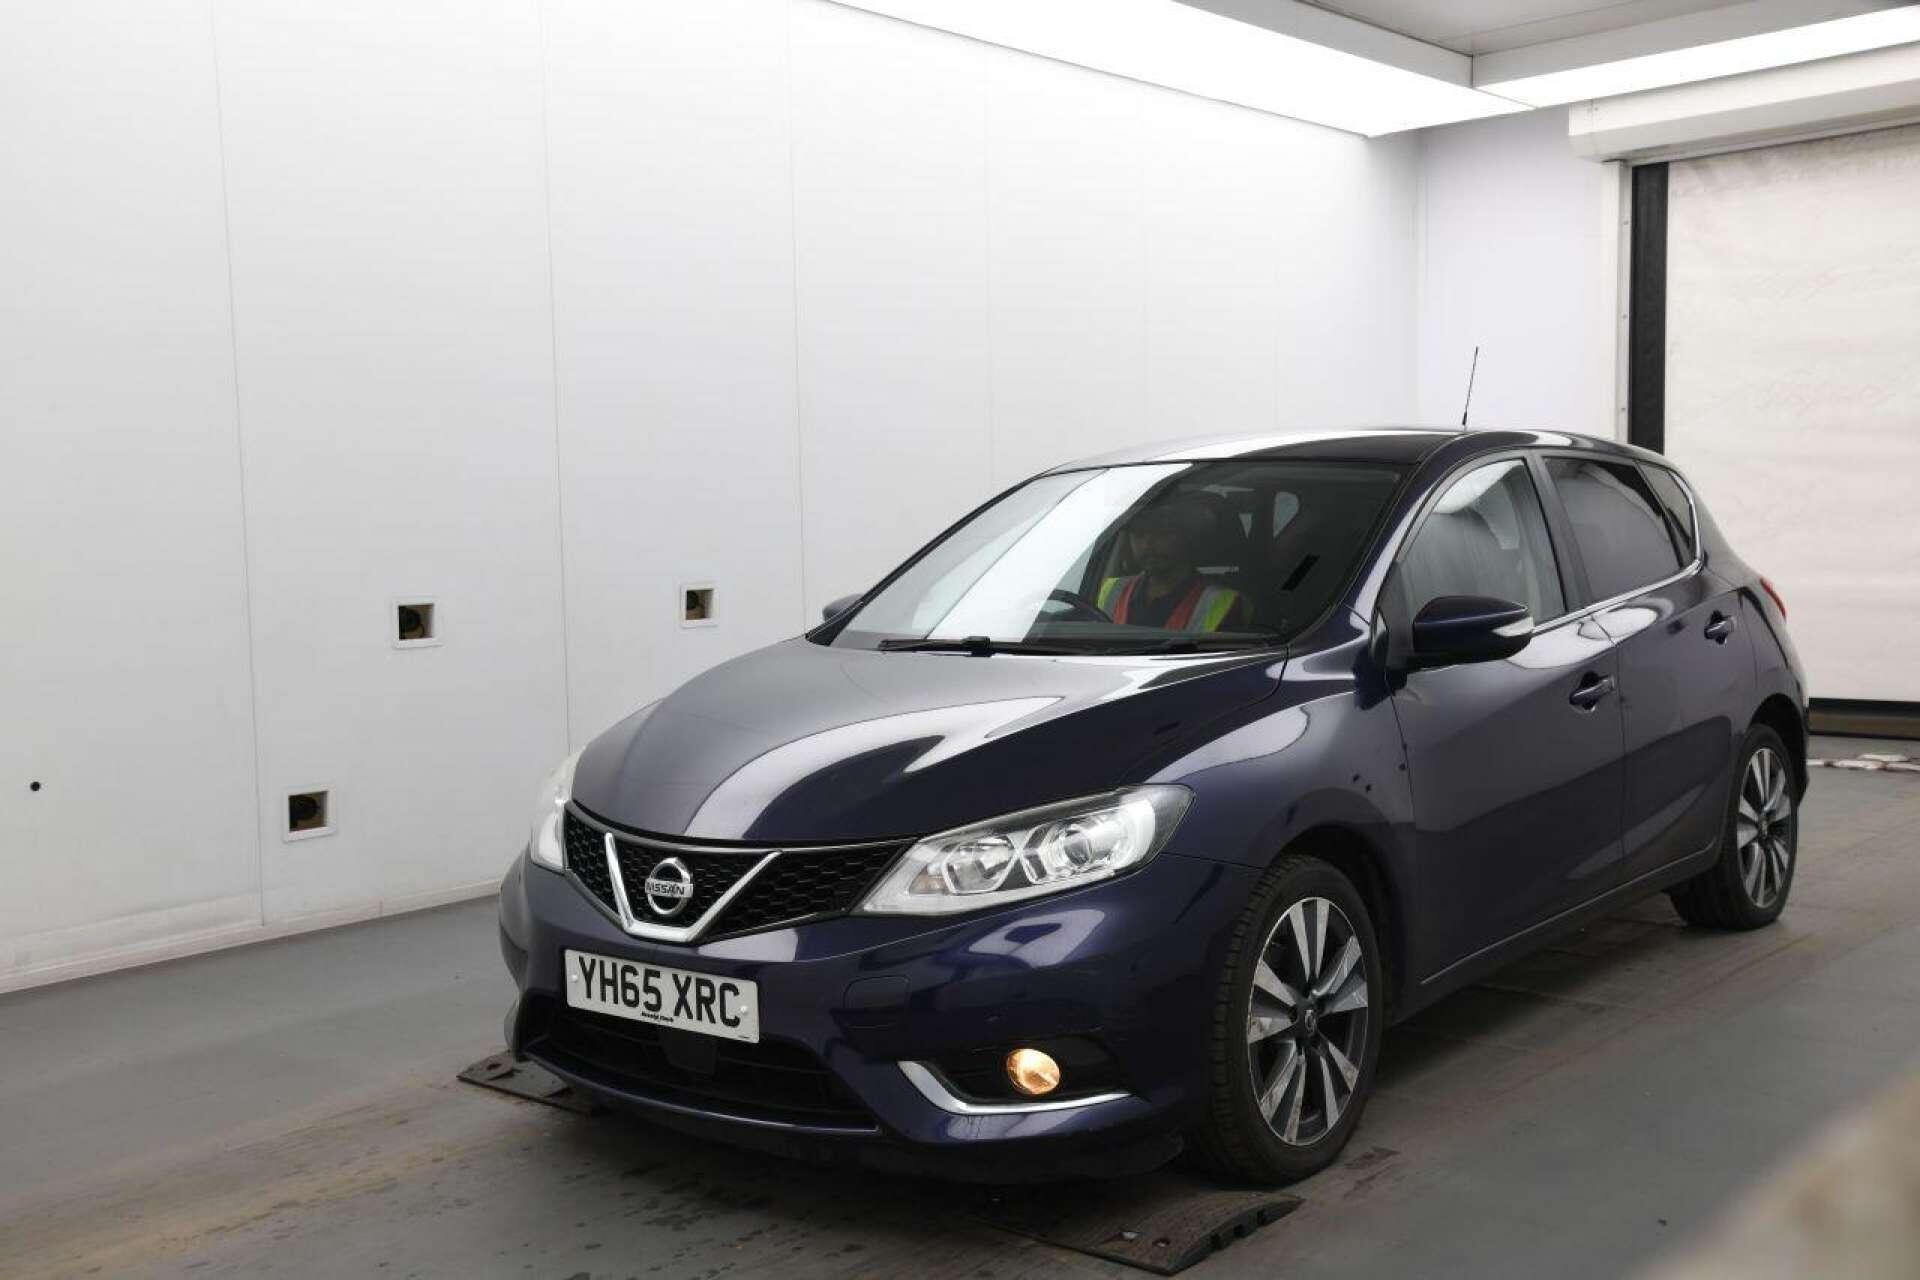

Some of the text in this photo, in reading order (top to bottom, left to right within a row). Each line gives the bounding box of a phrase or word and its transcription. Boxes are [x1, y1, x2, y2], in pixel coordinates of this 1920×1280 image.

[645, 881, 687, 896] NISSAN
[578, 955, 741, 1029] YH65 XRC
